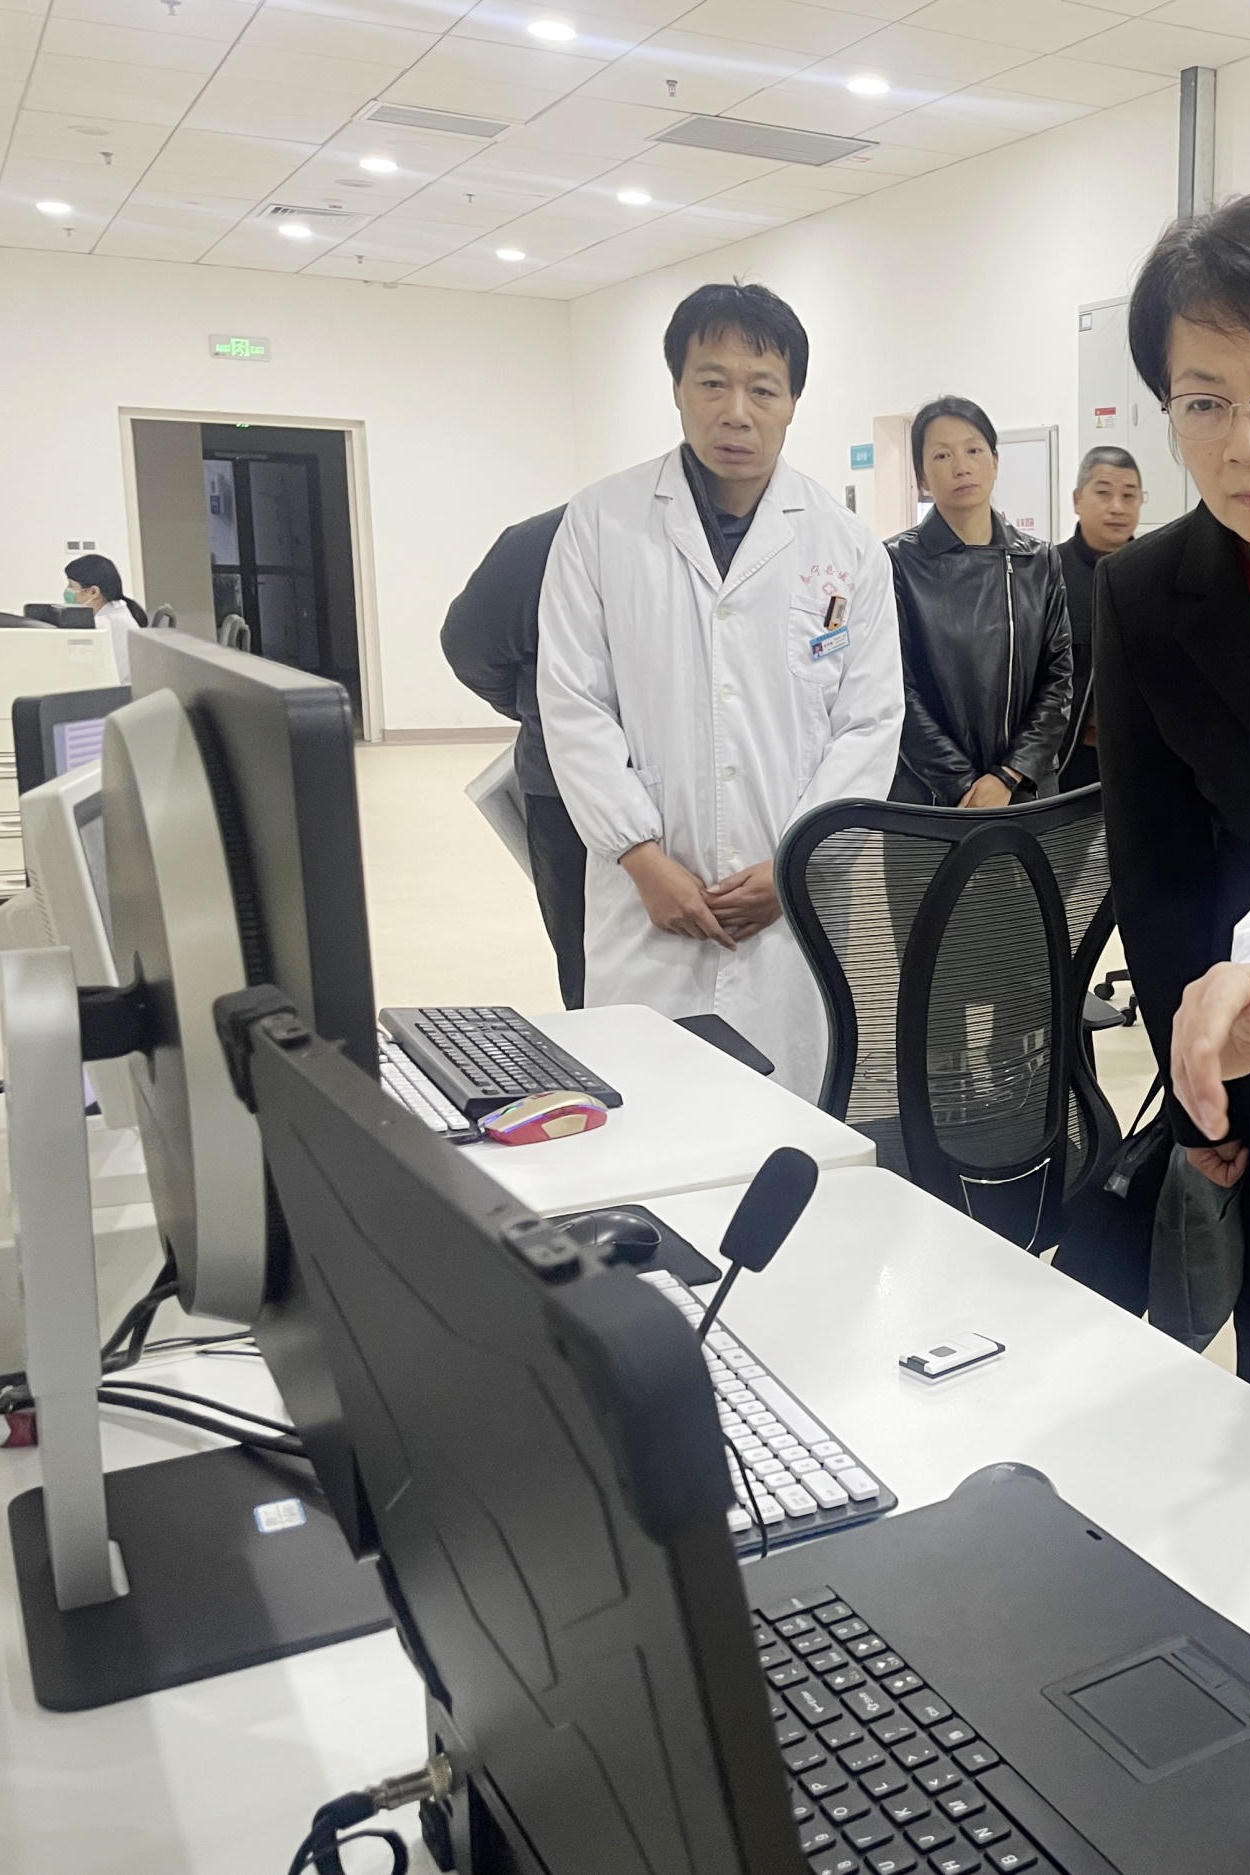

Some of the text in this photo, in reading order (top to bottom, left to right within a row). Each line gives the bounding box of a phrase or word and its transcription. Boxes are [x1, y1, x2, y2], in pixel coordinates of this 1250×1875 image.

[974, 1827, 993, 1838] N
[1001, 1854, 1018, 1864] B
[942, 1860, 961, 1871] H
